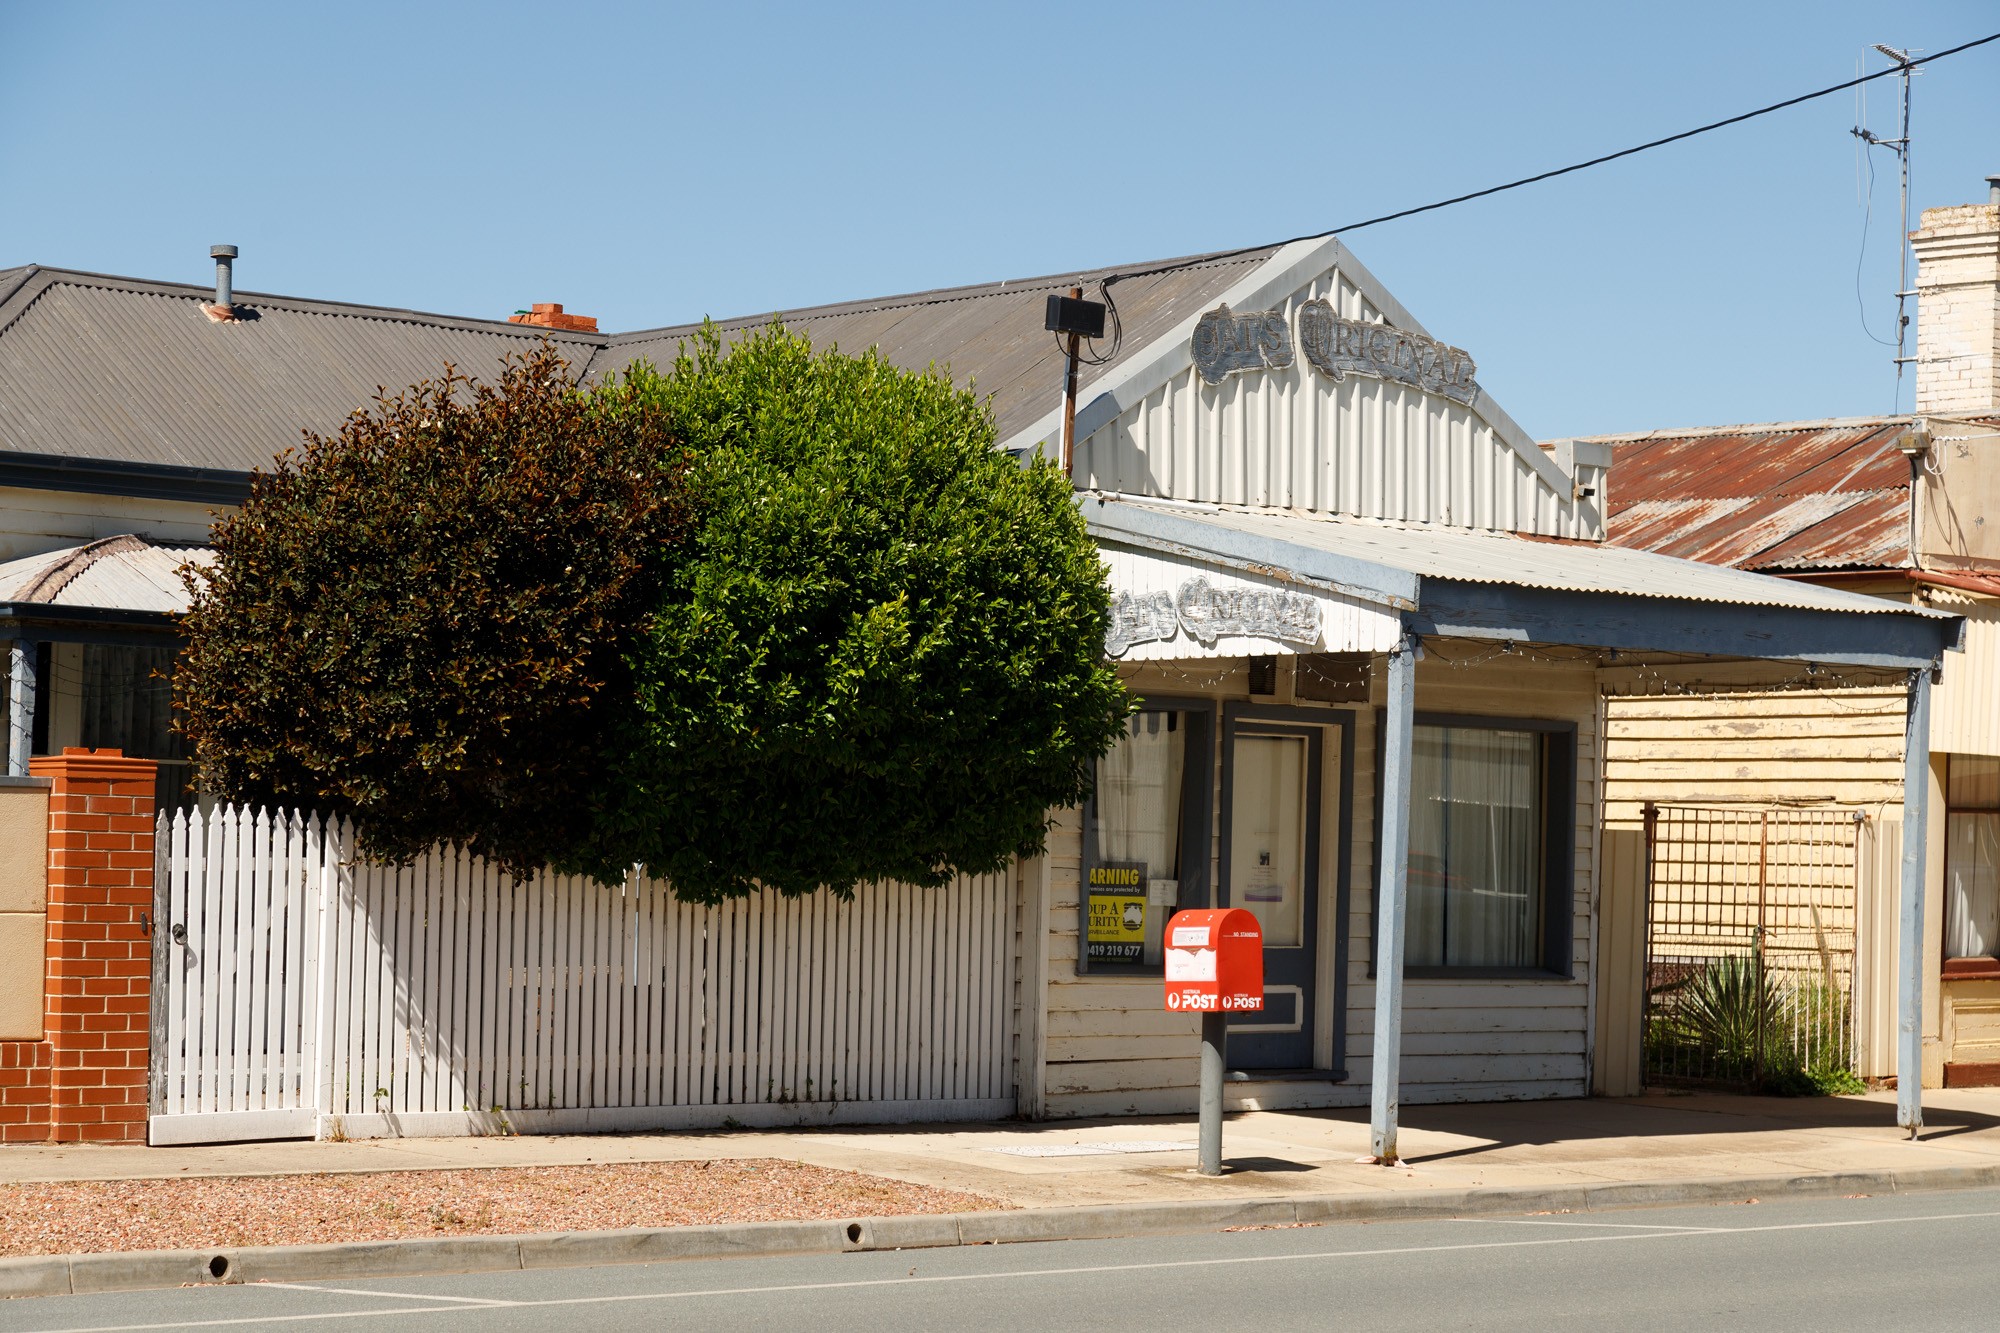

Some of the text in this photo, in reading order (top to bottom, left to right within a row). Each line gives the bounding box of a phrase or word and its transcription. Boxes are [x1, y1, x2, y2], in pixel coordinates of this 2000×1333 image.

[1301, 304, 1475, 389] ORIGINAL
[1110, 901, 1119, 915] A
[1088, 945, 1141, 956] 419 219 677
[1182, 994, 1218, 1009] POST
[1234, 997, 1261, 1008] POST
